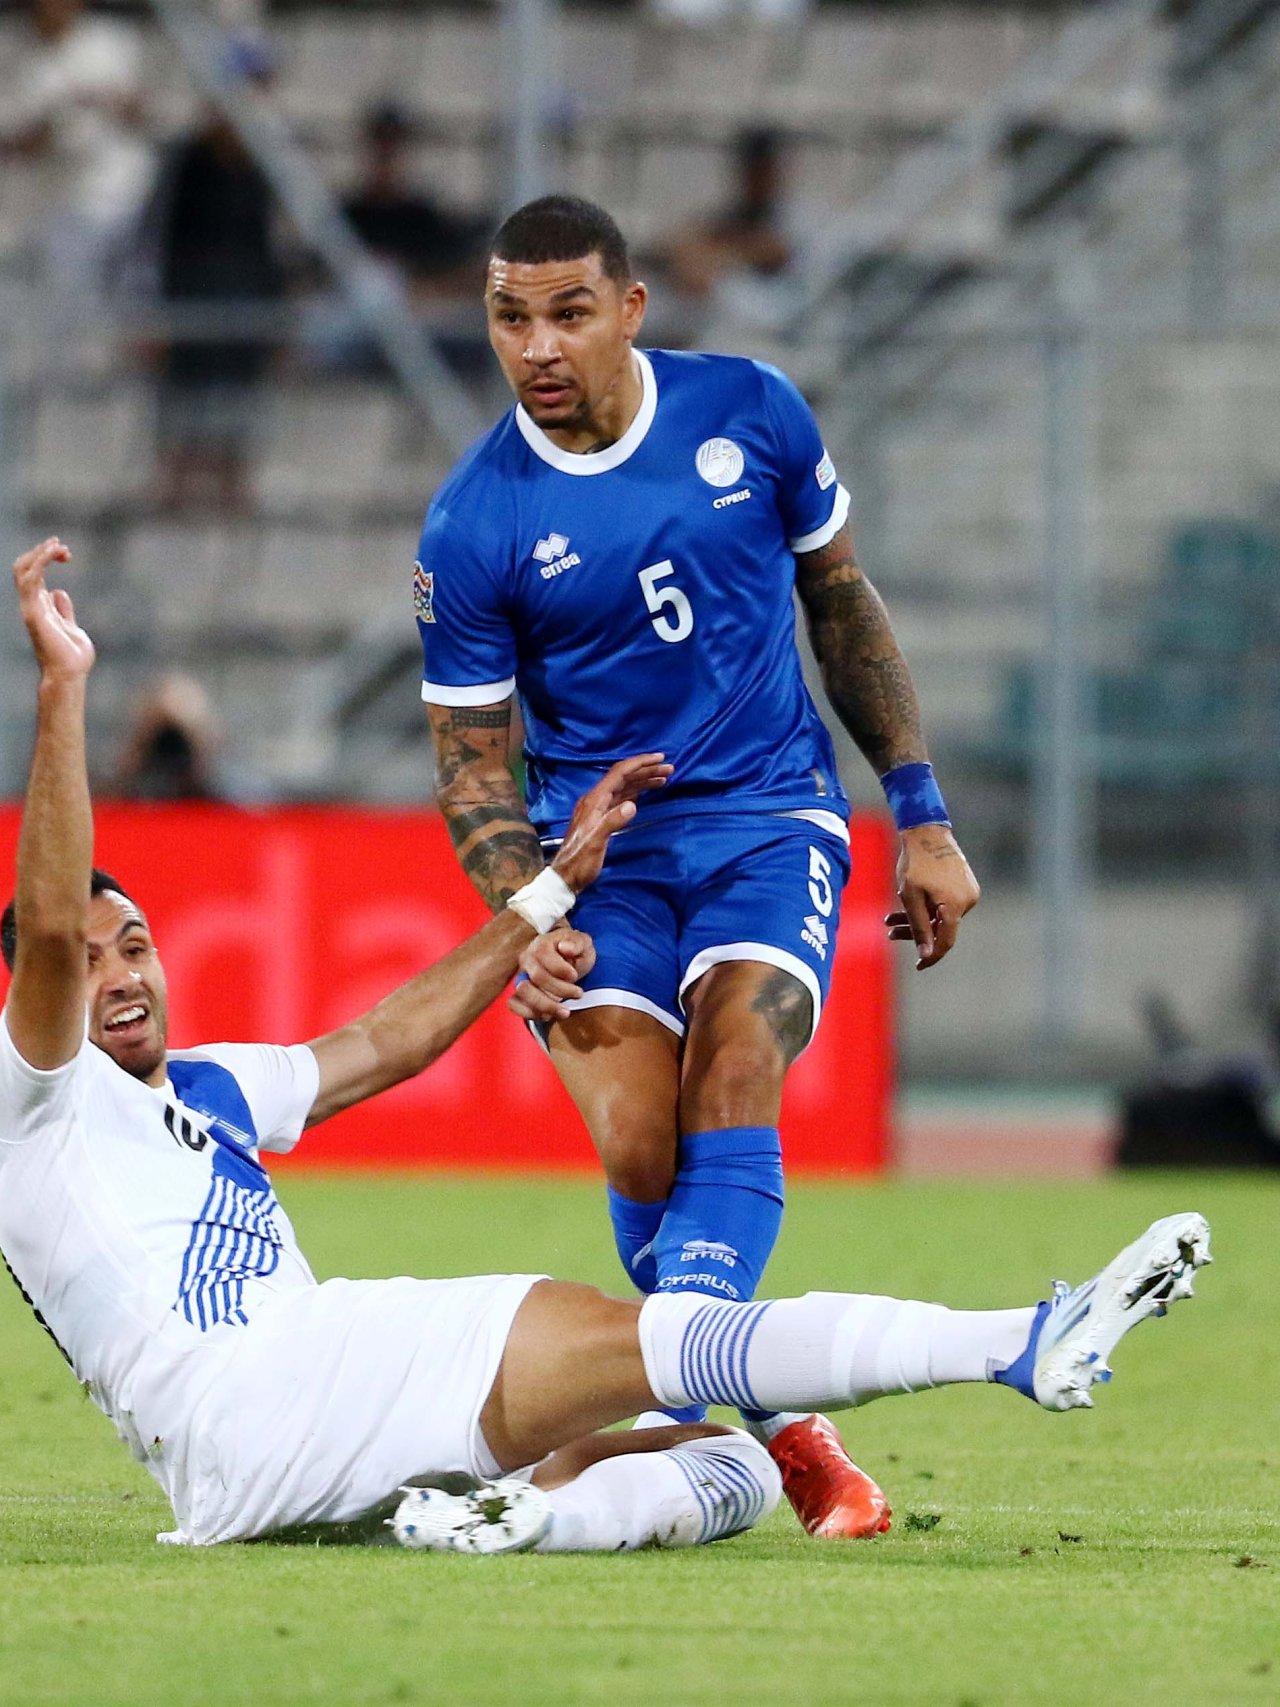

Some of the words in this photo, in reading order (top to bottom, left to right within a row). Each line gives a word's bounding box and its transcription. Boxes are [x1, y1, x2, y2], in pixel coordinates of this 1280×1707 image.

[713, 489, 751, 509] CYPRUS
[638, 560, 694, 643] 5
[808, 845, 833, 917] 5
[658, 1273, 740, 1298] CYPRUS
